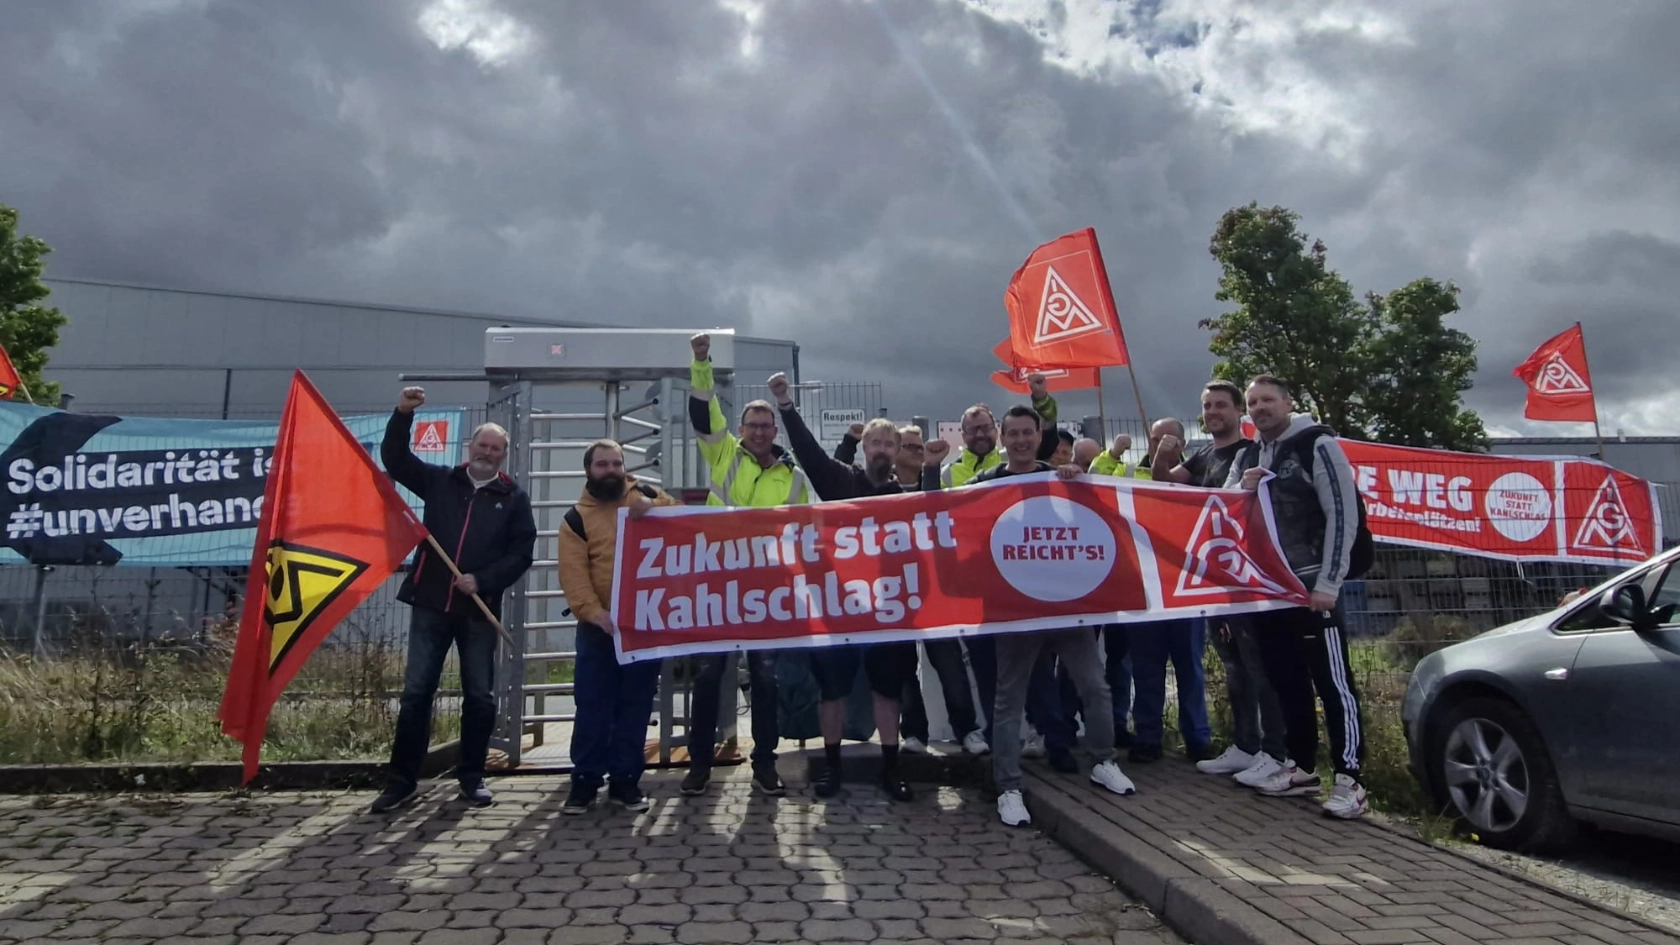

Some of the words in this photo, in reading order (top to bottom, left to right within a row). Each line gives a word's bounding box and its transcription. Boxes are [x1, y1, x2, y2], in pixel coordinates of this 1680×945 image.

[823, 411, 863, 422] Respekt!
[7, 450, 240, 494] Solidarität
[1350, 465, 1379, 500] E
[1387, 468, 1473, 512] WEG
[1500, 489, 1538, 502] ZUKUNFT
[1363, 498, 1481, 533] rbeitsplätzen!
[1505, 500, 1532, 511] STATT
[636, 521, 820, 579] Zukunft
[833, 510, 957, 559] statt
[1023, 526, 1079, 543] JETZT
[1003, 544, 1105, 560] REICHT'S!
[634, 562, 922, 632] Kahlschlag!
